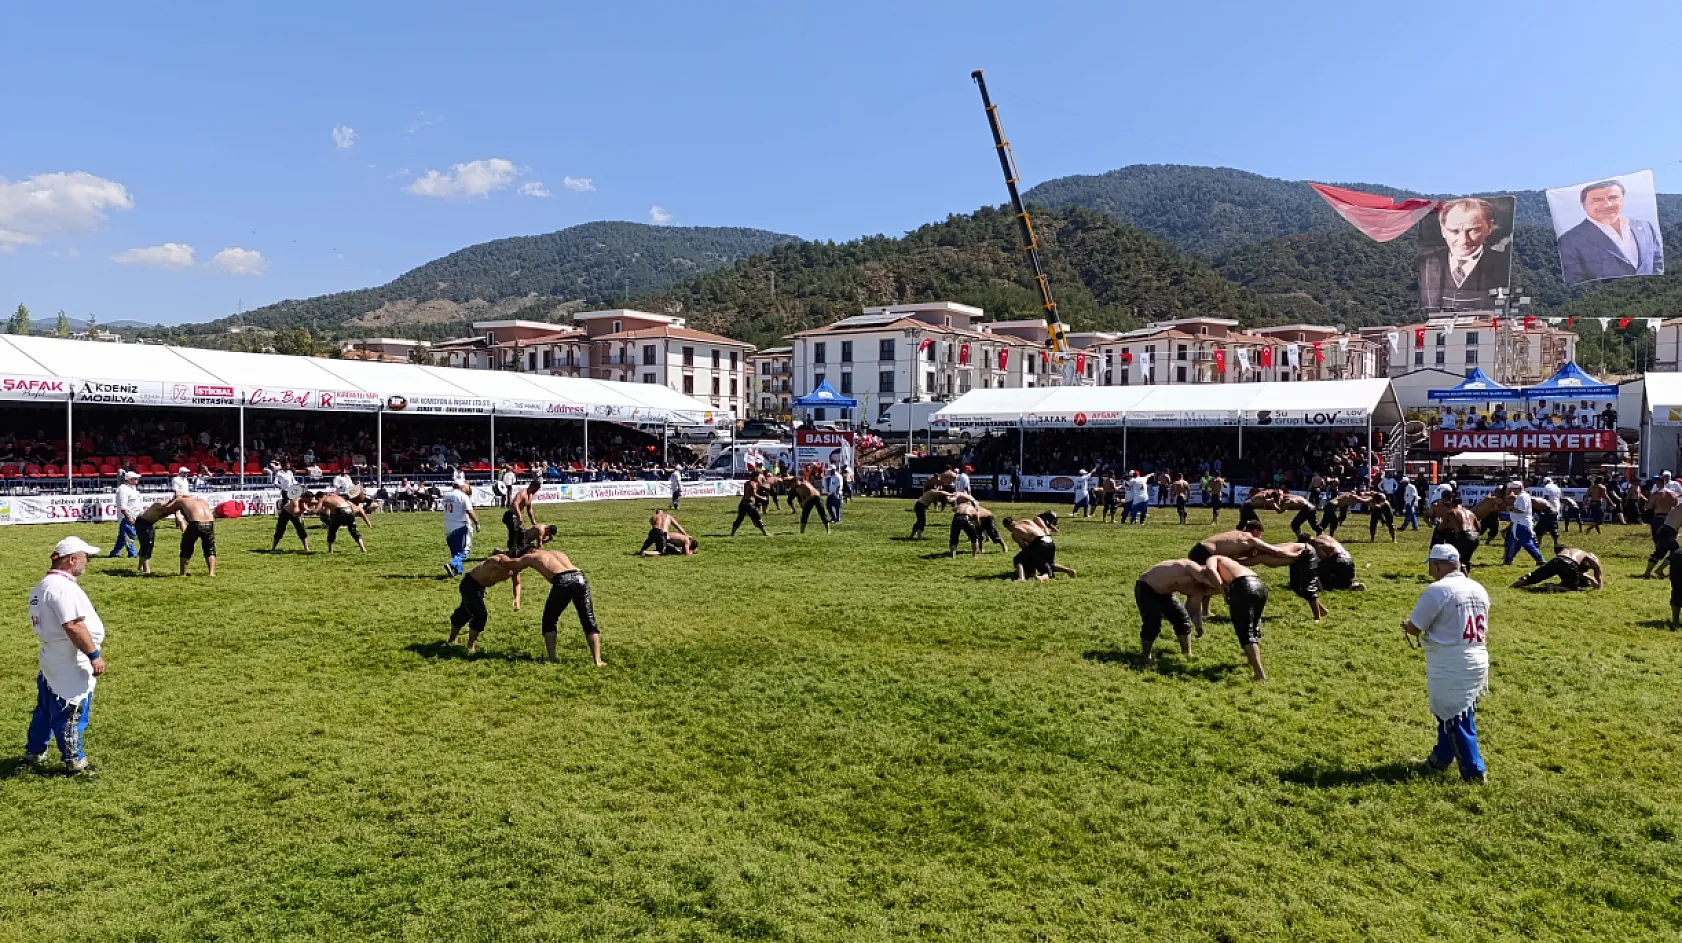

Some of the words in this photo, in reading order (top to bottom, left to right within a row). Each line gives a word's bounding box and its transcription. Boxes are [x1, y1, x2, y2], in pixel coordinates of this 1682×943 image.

[3, 378, 63, 392] ŞAFAK
[547, 403, 584, 413] Address
[805, 433, 843, 444] BASIN
[1443, 433, 1518, 449] HAKEM
[1523, 432, 1601, 449] HEYETİ
